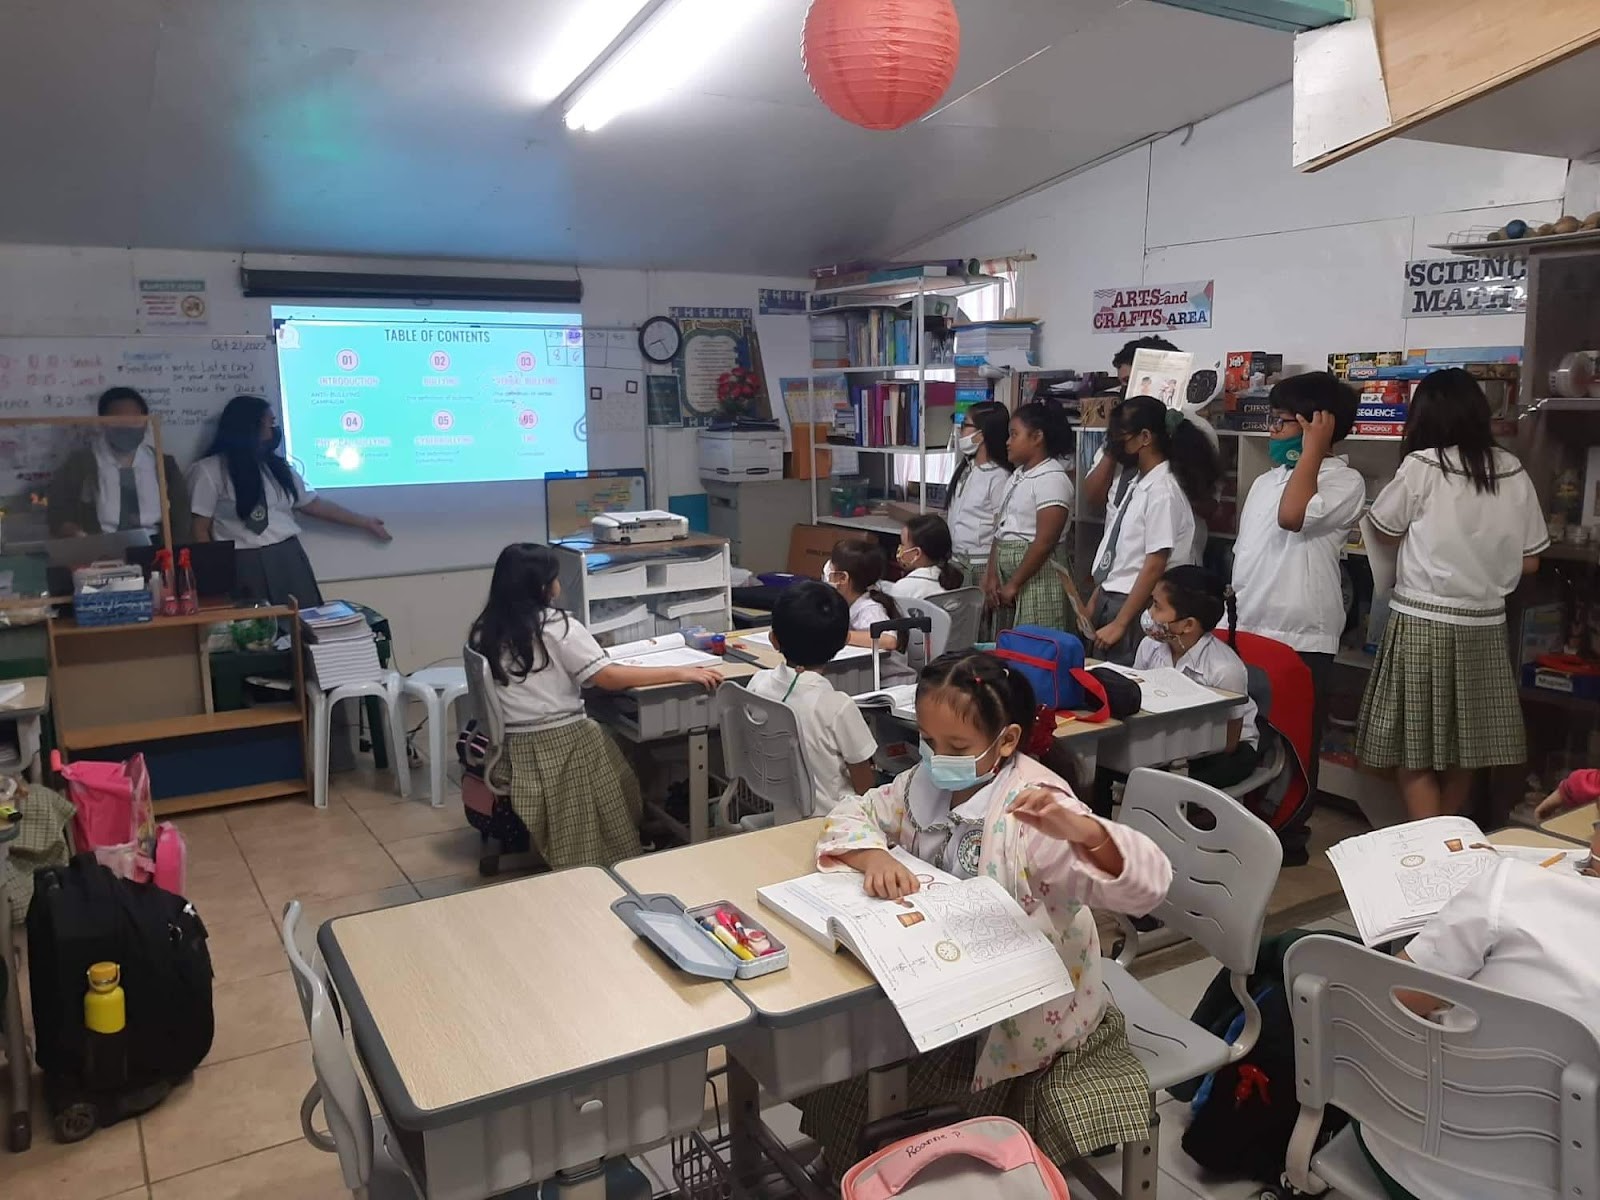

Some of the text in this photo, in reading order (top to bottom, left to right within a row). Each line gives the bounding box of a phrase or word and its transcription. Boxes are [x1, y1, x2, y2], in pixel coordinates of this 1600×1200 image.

[1409, 259, 1527, 287] SCIENC
[1112, 288, 1188, 308] ARTS and
[1411, 288, 1512, 313] MATH
[1093, 309, 1208, 329] CRAFTS AREA
[384, 329, 490, 343] TABLE OF CONTENTS
[342, 355, 352, 366] 01
[434, 356, 445, 367] 02
[521, 357, 531, 367] 03
[1356, 408, 1396, 417] SEQUENCE
[346, 417, 358, 427] 04
[1361, 424, 1392, 433] MONOPOLY
[905, 1134, 948, 1158] Roanne
